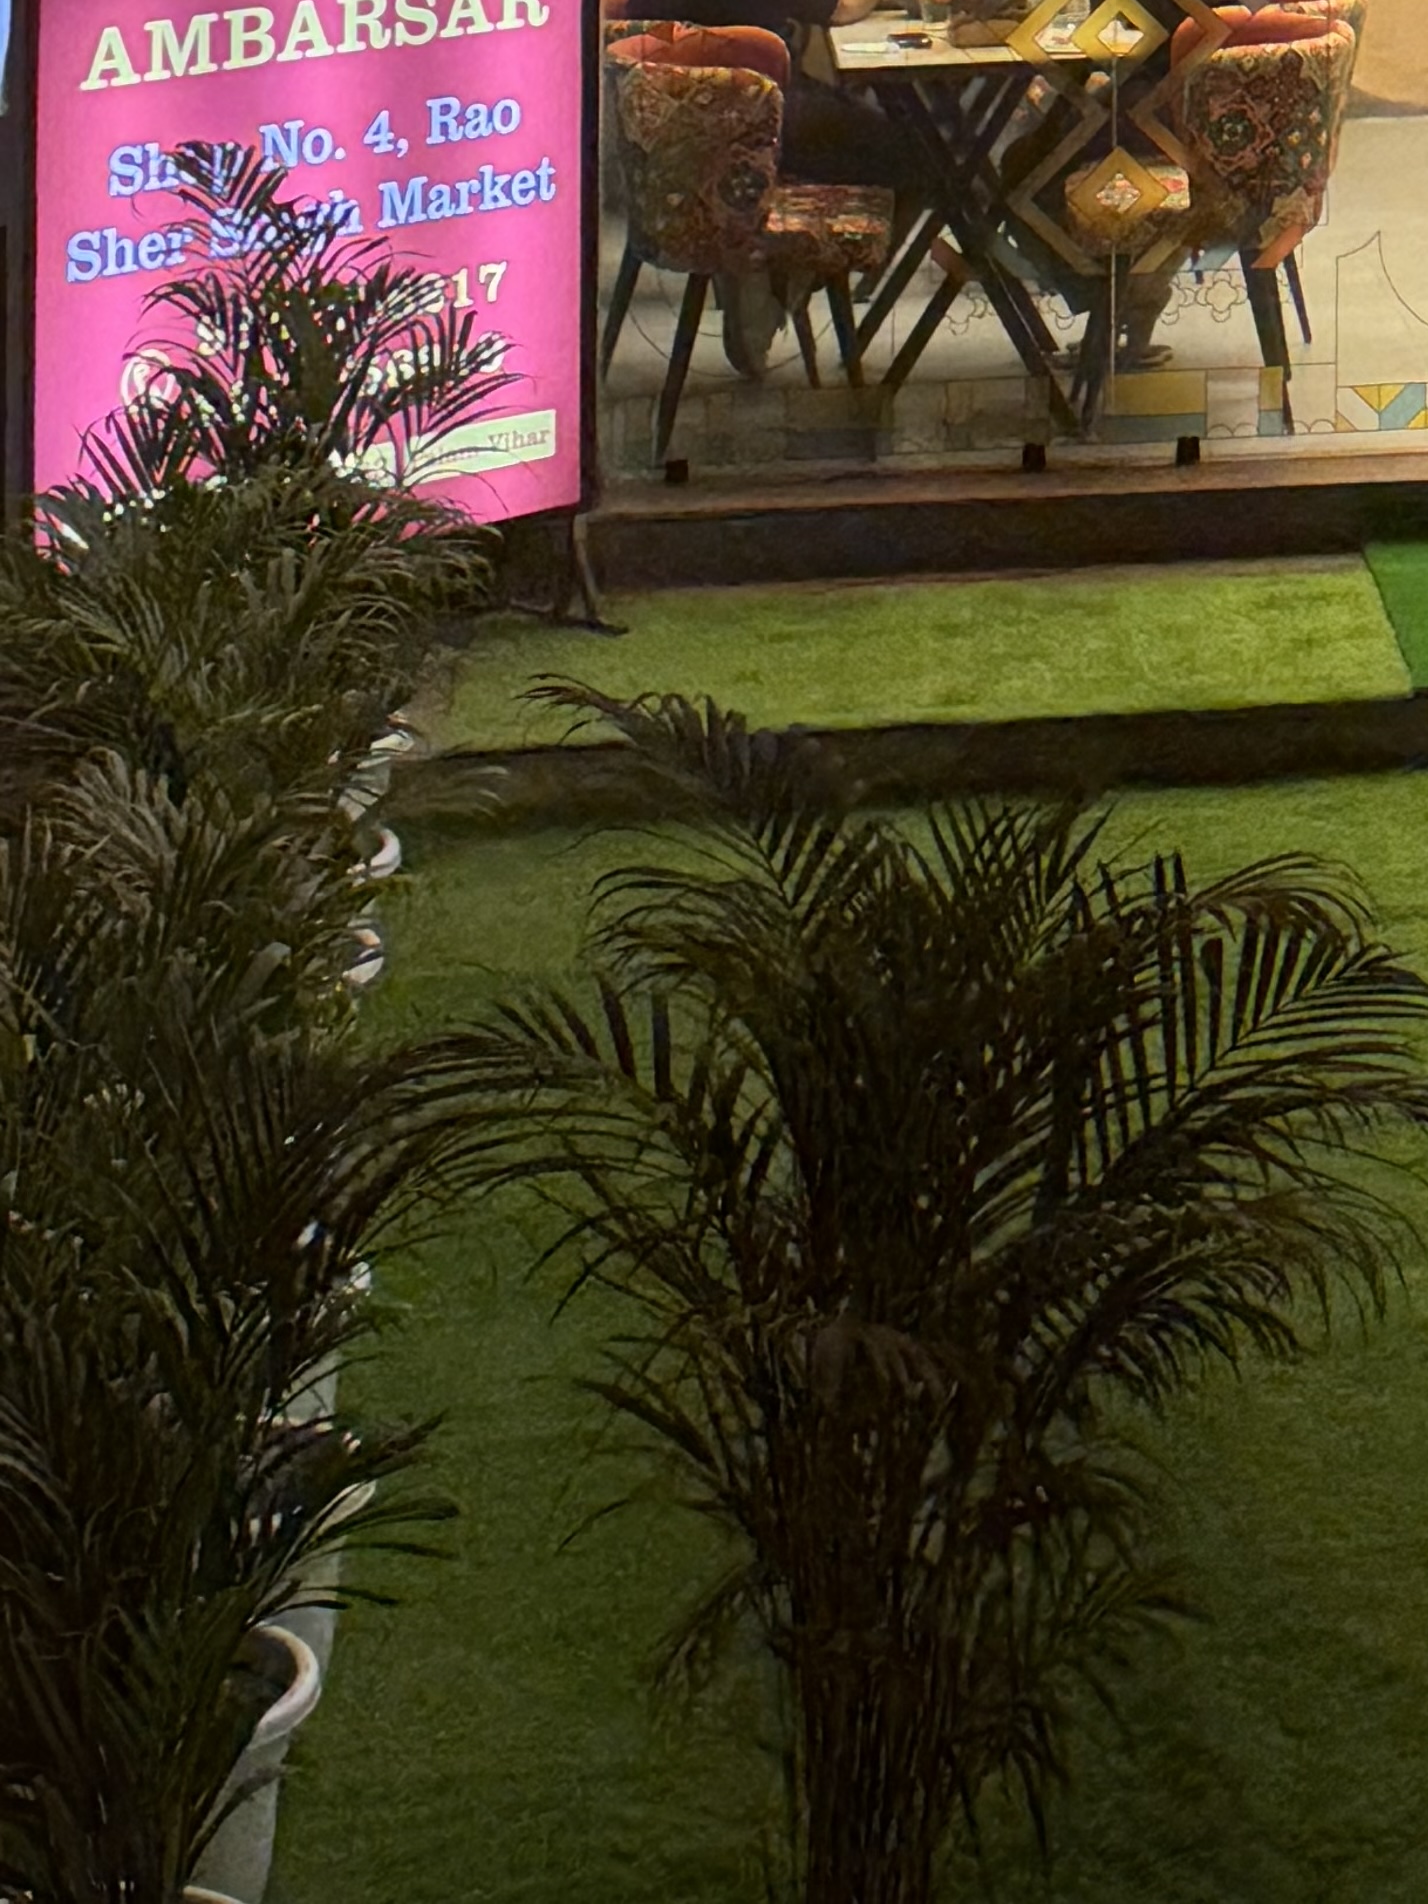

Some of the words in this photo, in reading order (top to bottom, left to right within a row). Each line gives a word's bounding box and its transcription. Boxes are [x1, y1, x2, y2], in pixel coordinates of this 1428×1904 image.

[258, 118, 347, 174] No.
[362, 108, 410, 159] 4,
[425, 95, 522, 145] Rao
[65, 226, 194, 283] Sher
[377, 155, 557, 229] Market
